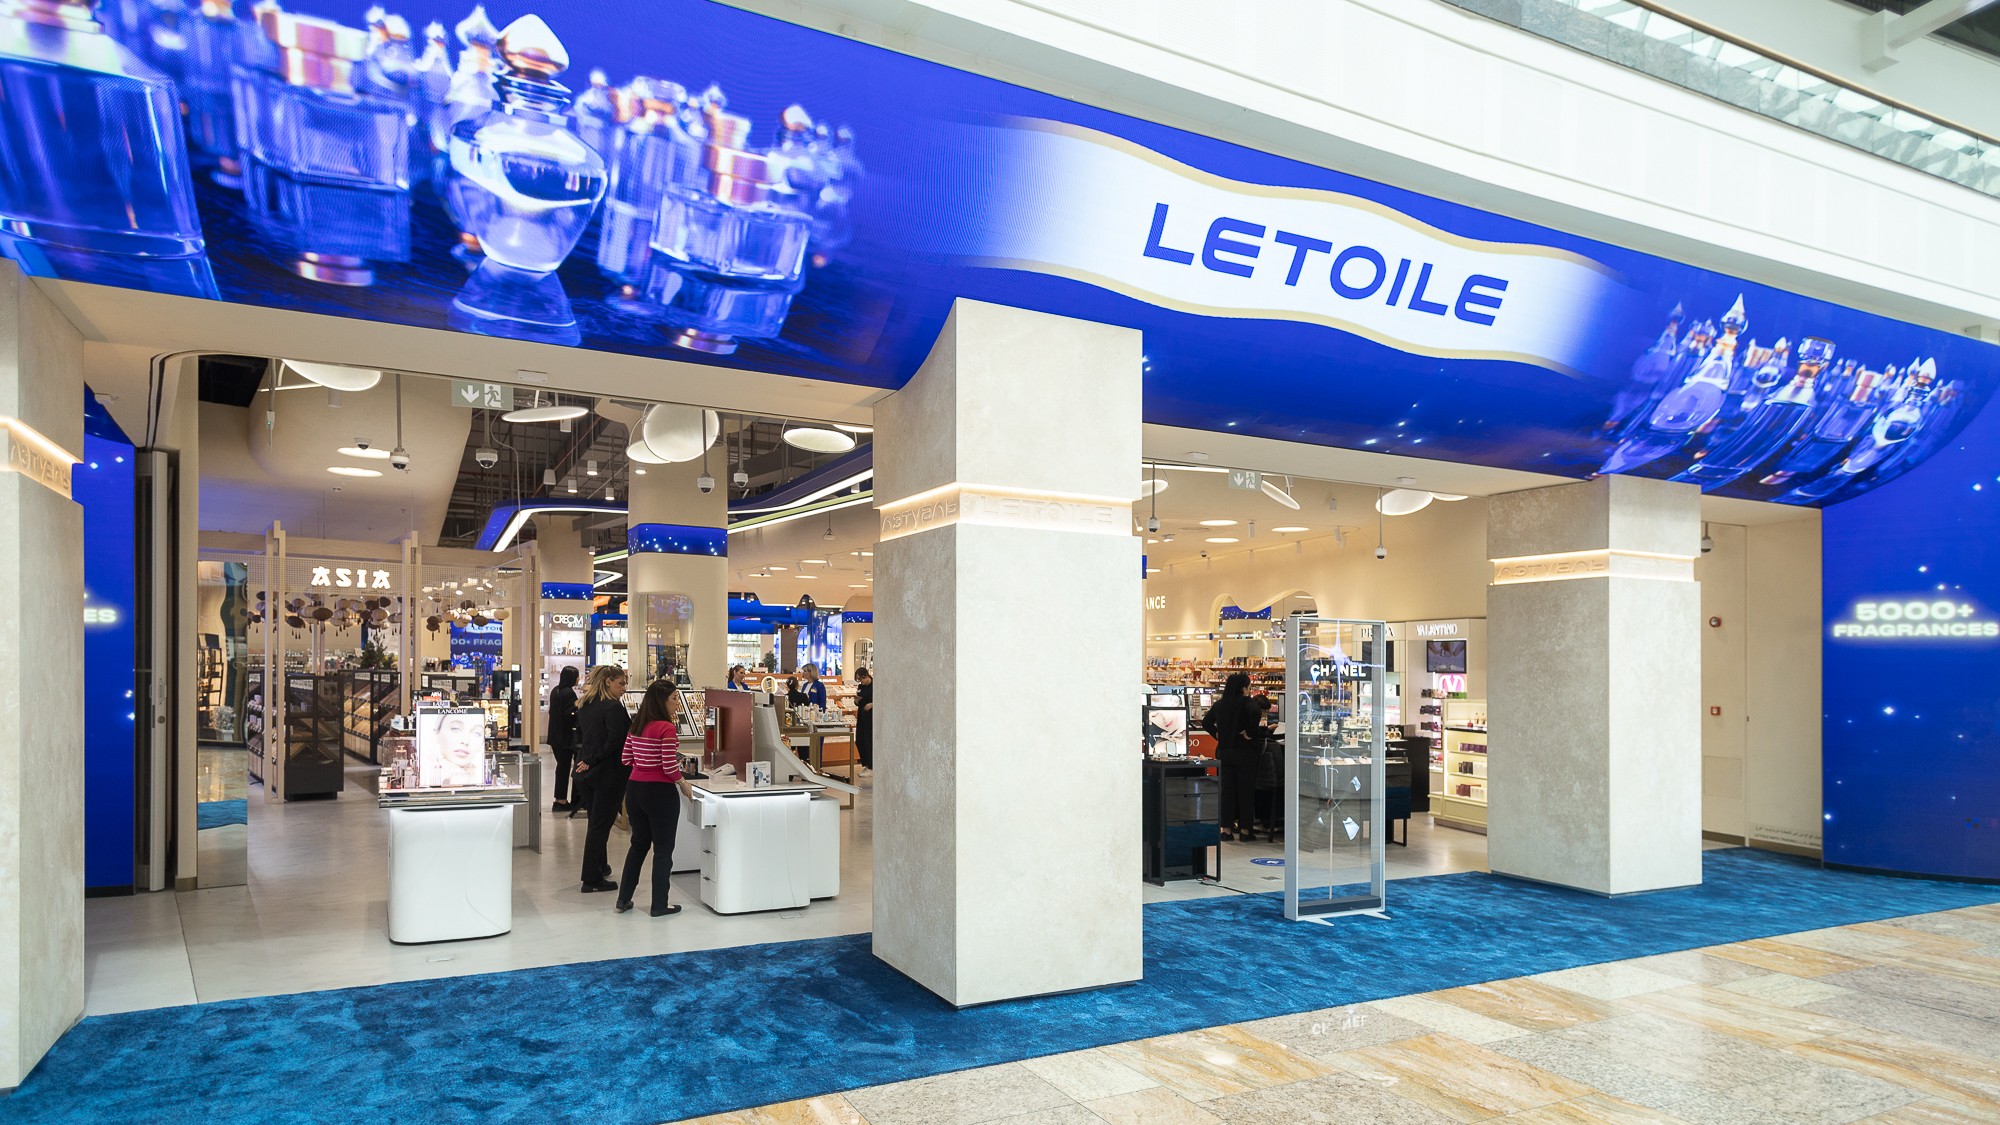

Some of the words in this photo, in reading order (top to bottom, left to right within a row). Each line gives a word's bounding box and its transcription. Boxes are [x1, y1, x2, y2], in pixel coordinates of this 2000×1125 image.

[1143, 202, 1509, 327] LETOILE
[980, 495, 1113, 526] LETOILE
[310, 565, 391, 590] ASIA
[1855, 601, 1974, 621] 5000+
[1833, 622, 1999, 638] FRAGRANCES
